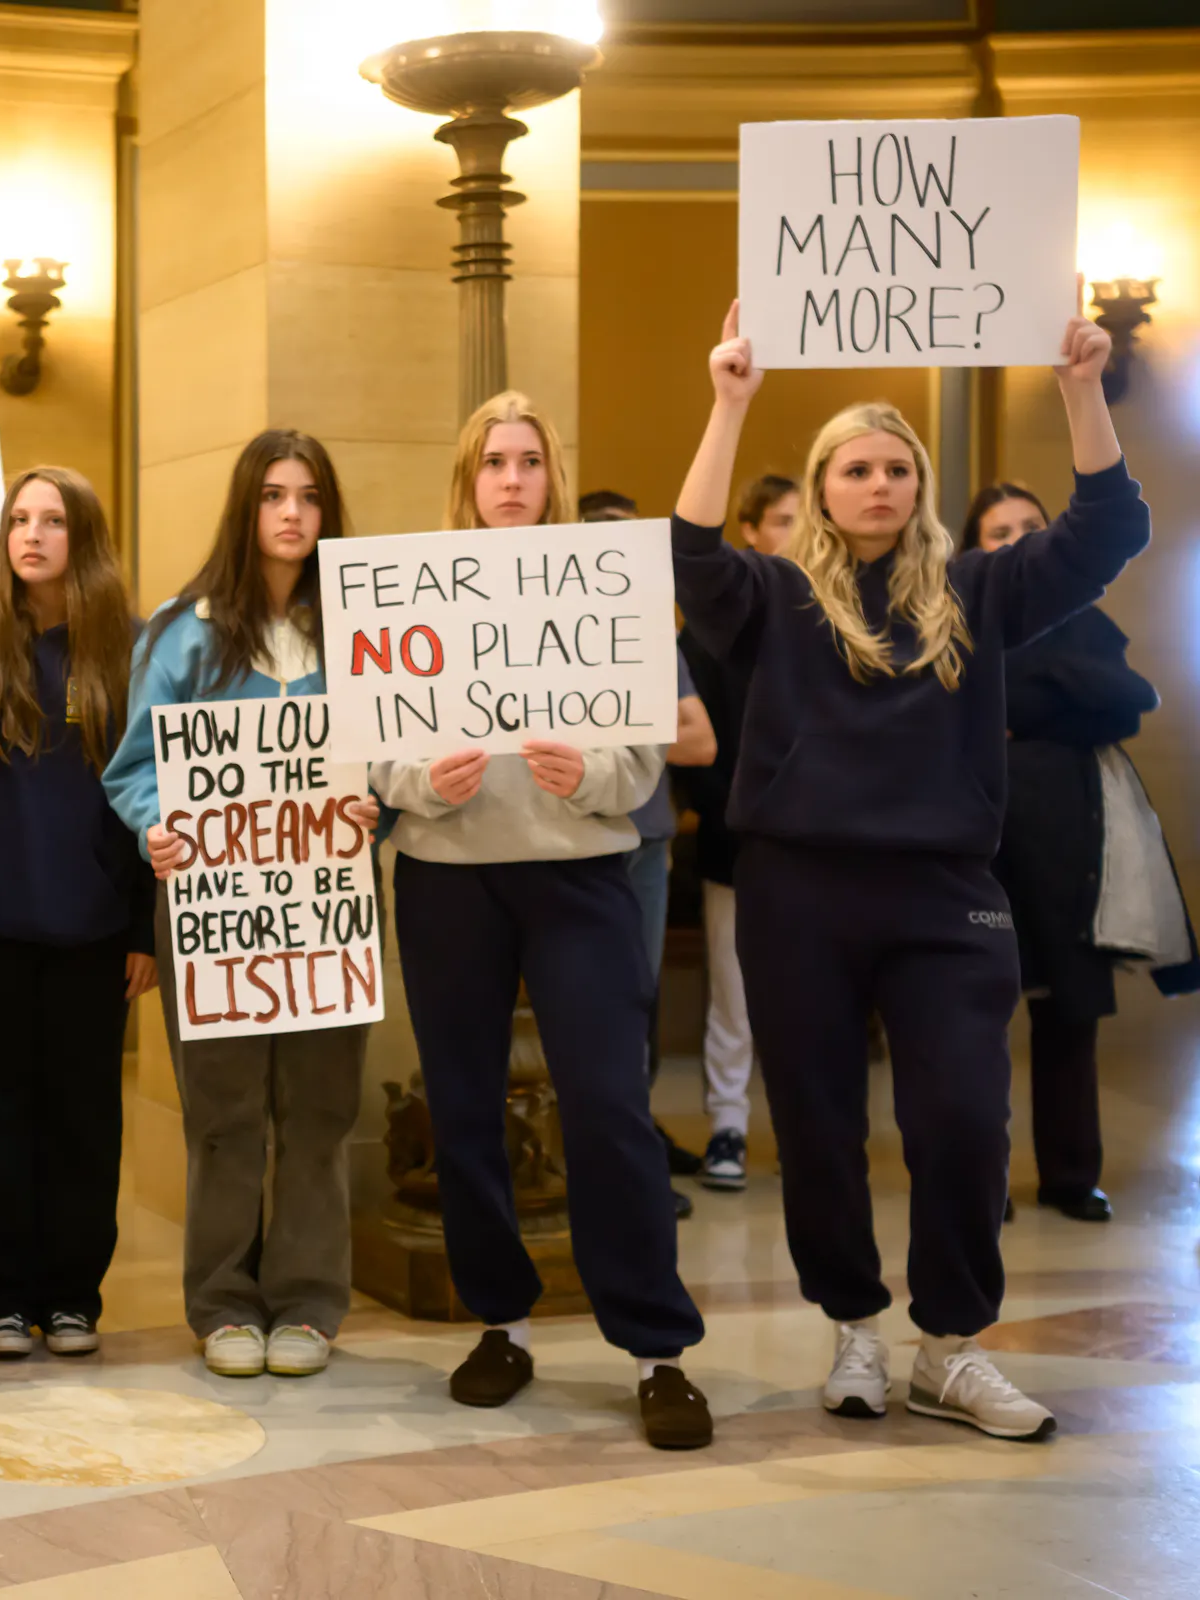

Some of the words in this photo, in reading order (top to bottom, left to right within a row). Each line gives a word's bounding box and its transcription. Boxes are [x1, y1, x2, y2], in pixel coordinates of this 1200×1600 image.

[828, 132, 957, 208] HOW
[776, 206, 990, 276] MANY
[800, 282, 1005, 356] MORE?
[339, 557, 491, 610] FEAR
[517, 550, 631, 597] HAS
[351, 624, 445, 677] NO
[472, 614, 644, 671] PLACE
[159, 706, 241, 763] HOW
[257, 701, 331, 754] LOU
[376, 686, 439, 743] IN
[461, 680, 654, 739] SCHOOL
[188, 762, 246, 801] DO
[260, 756, 329, 795] THE
[166, 794, 365, 871] SCREAMS
[174, 871, 250, 906] HAVE
[260, 870, 293, 897] TO
[314, 866, 356, 895] BE
[176, 901, 307, 956] BEFORE
[311, 894, 374, 946] YOU
[967, 910, 1013, 927] COM
